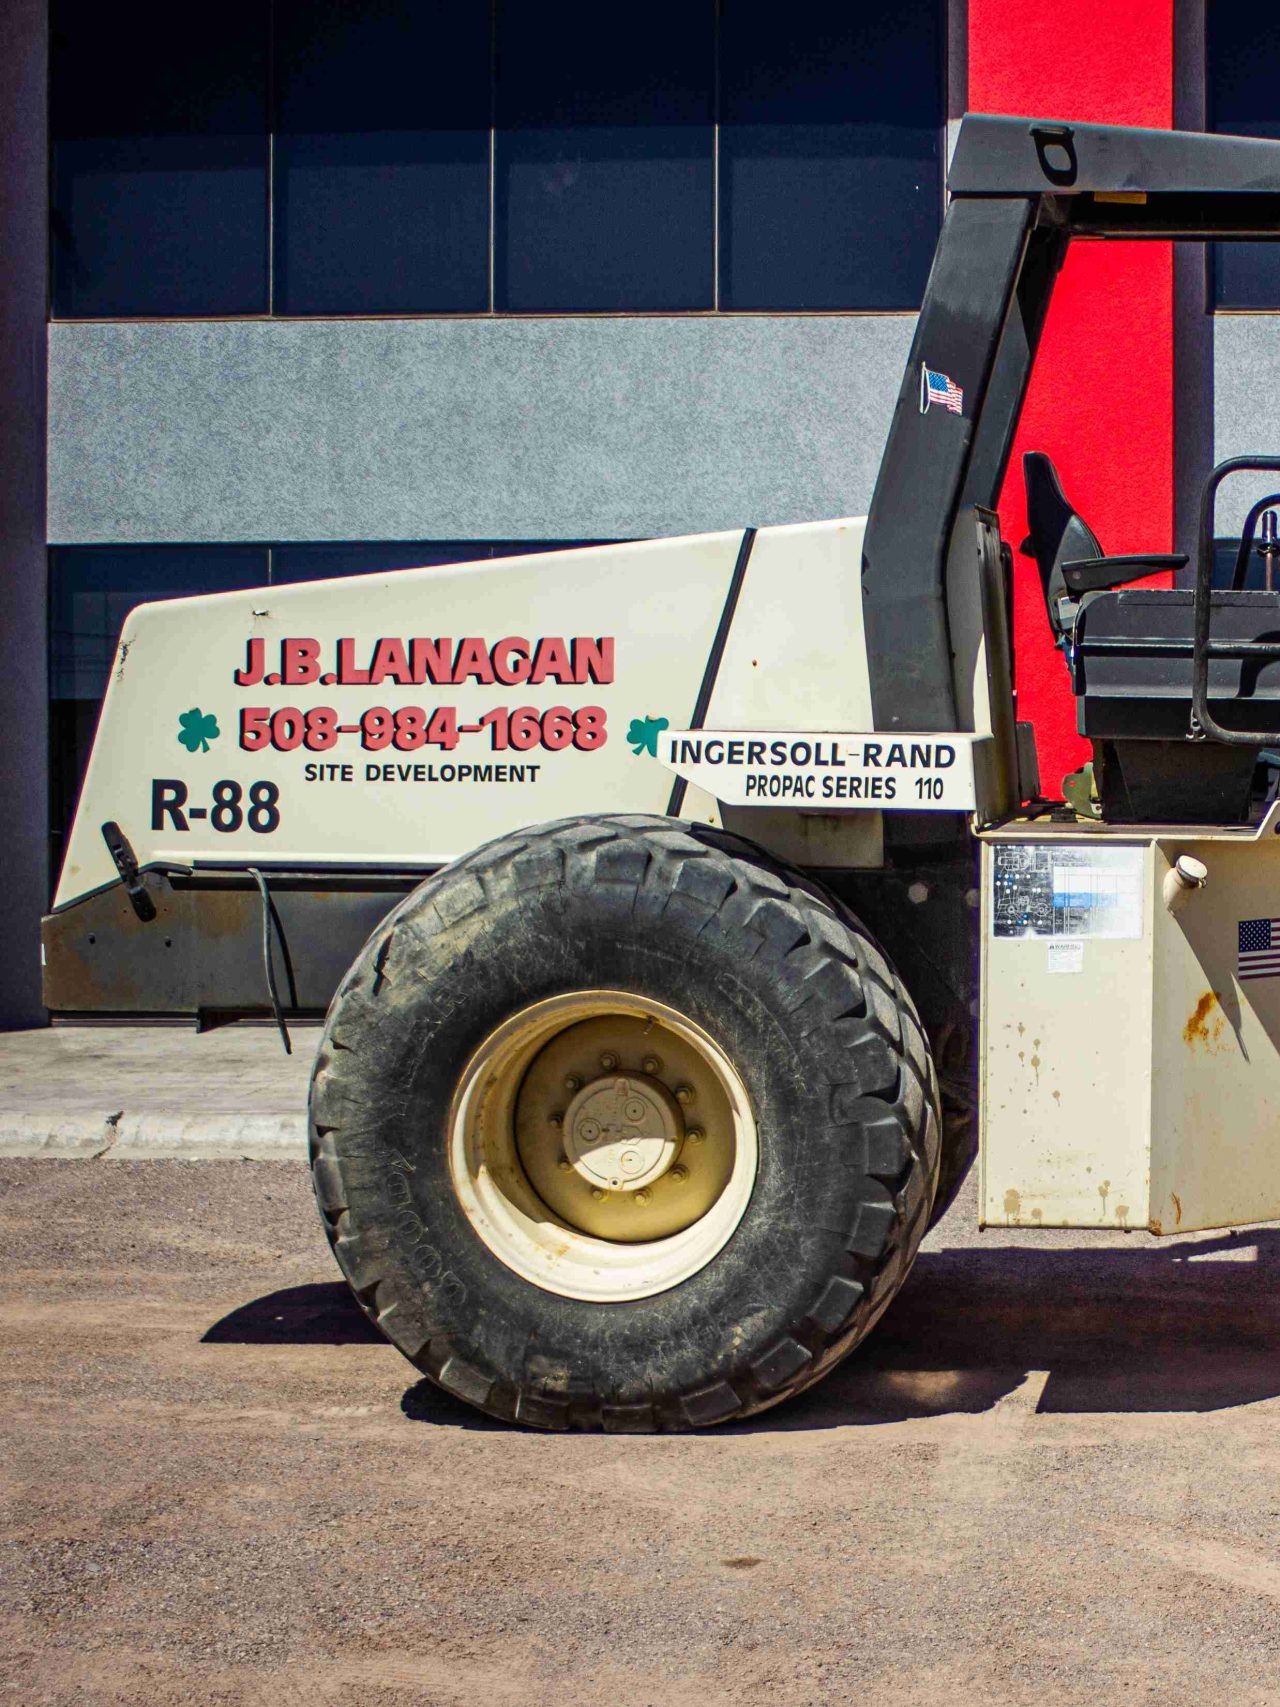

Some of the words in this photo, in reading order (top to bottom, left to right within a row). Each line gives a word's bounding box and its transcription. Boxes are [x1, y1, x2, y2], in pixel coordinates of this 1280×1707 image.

[239, 706, 608, 752] 508-984-1668
[304, 764, 353, 783] SITE
[365, 763, 541, 784] DEVELOPMENT
[746, 774, 816, 798] PROPAC
[822, 775, 896, 799] SERIES
[915, 777, 944, 800] 110
[150, 778, 281, 834] R-88
